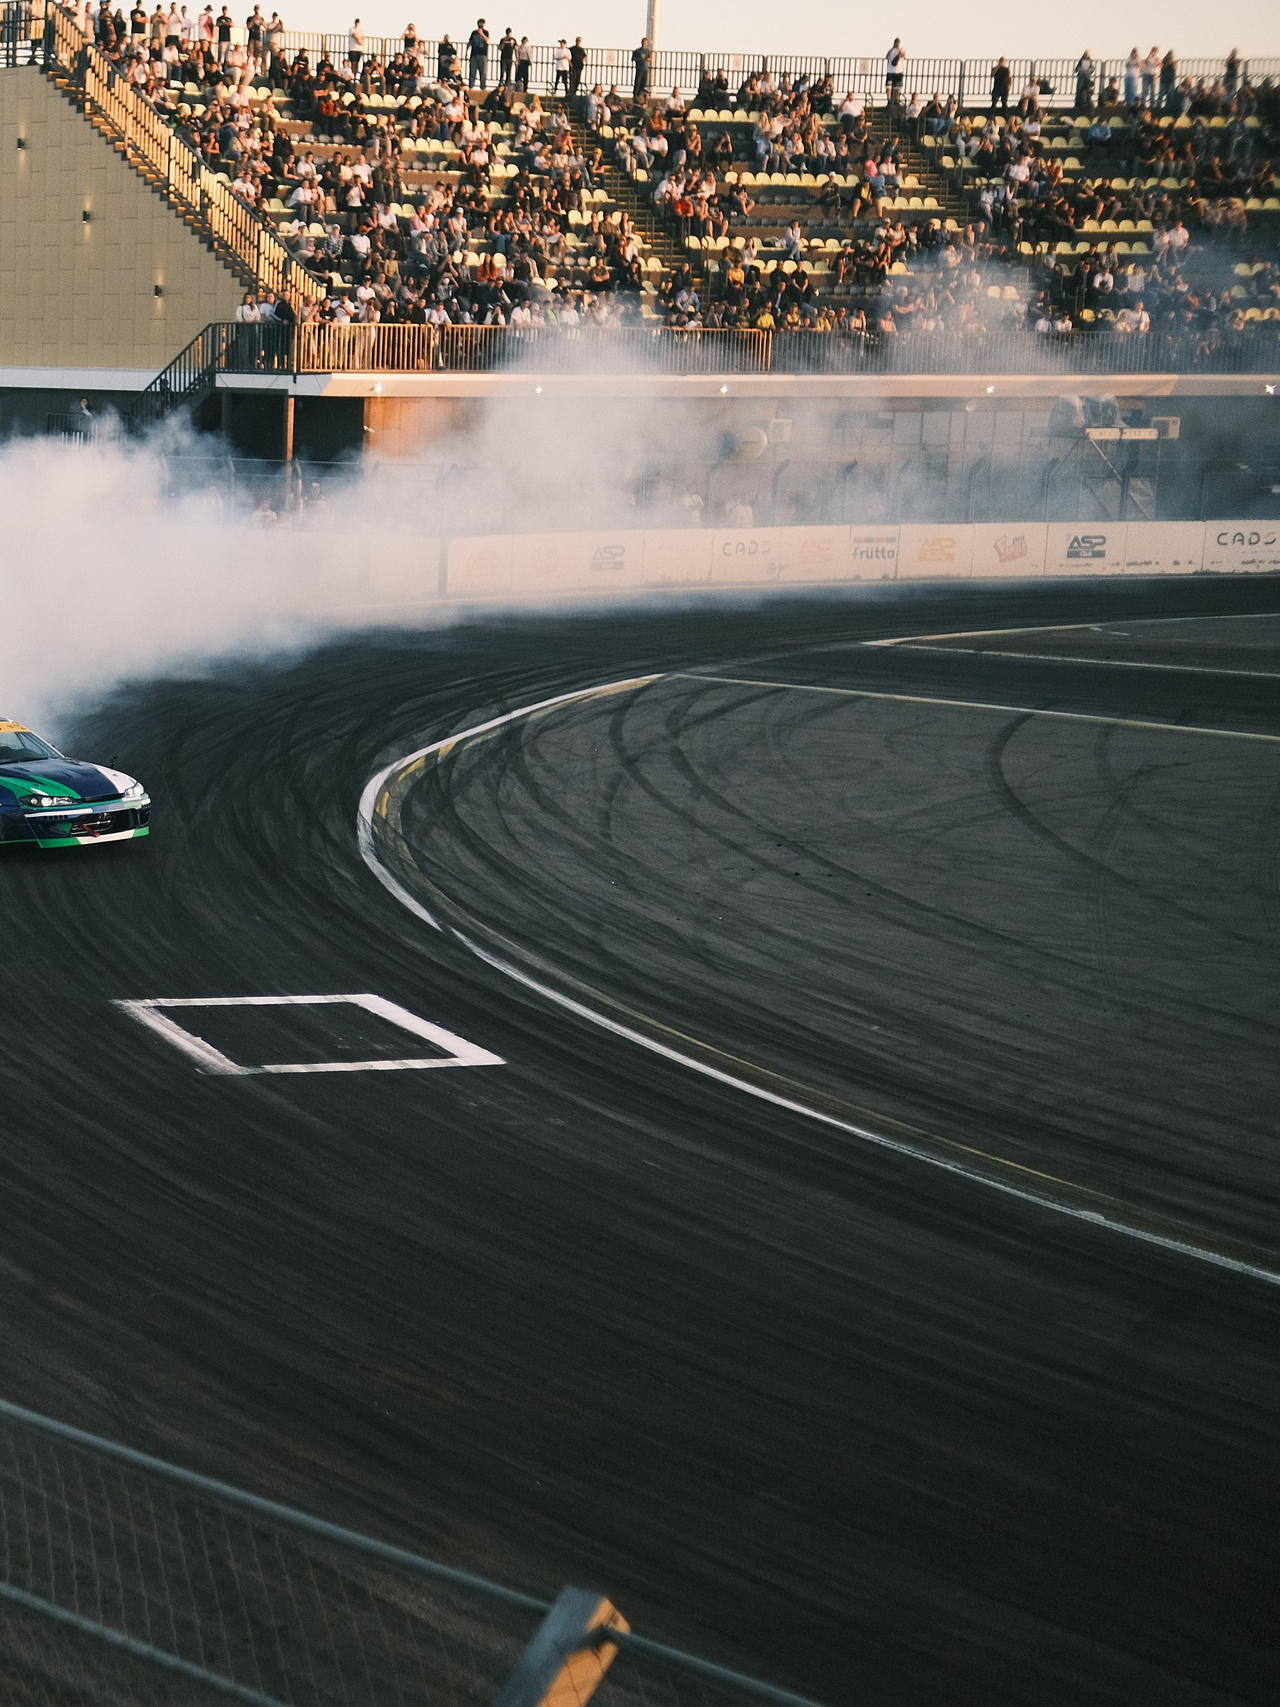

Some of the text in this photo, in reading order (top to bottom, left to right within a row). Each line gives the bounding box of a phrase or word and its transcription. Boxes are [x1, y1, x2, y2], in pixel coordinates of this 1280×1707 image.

[1068, 535, 1108, 549] ASP
[1216, 531, 1277, 546] CADS
[591, 545, 626, 561] ASP
[722, 541, 772, 557] CADS
[852, 545, 896, 560] frütta
